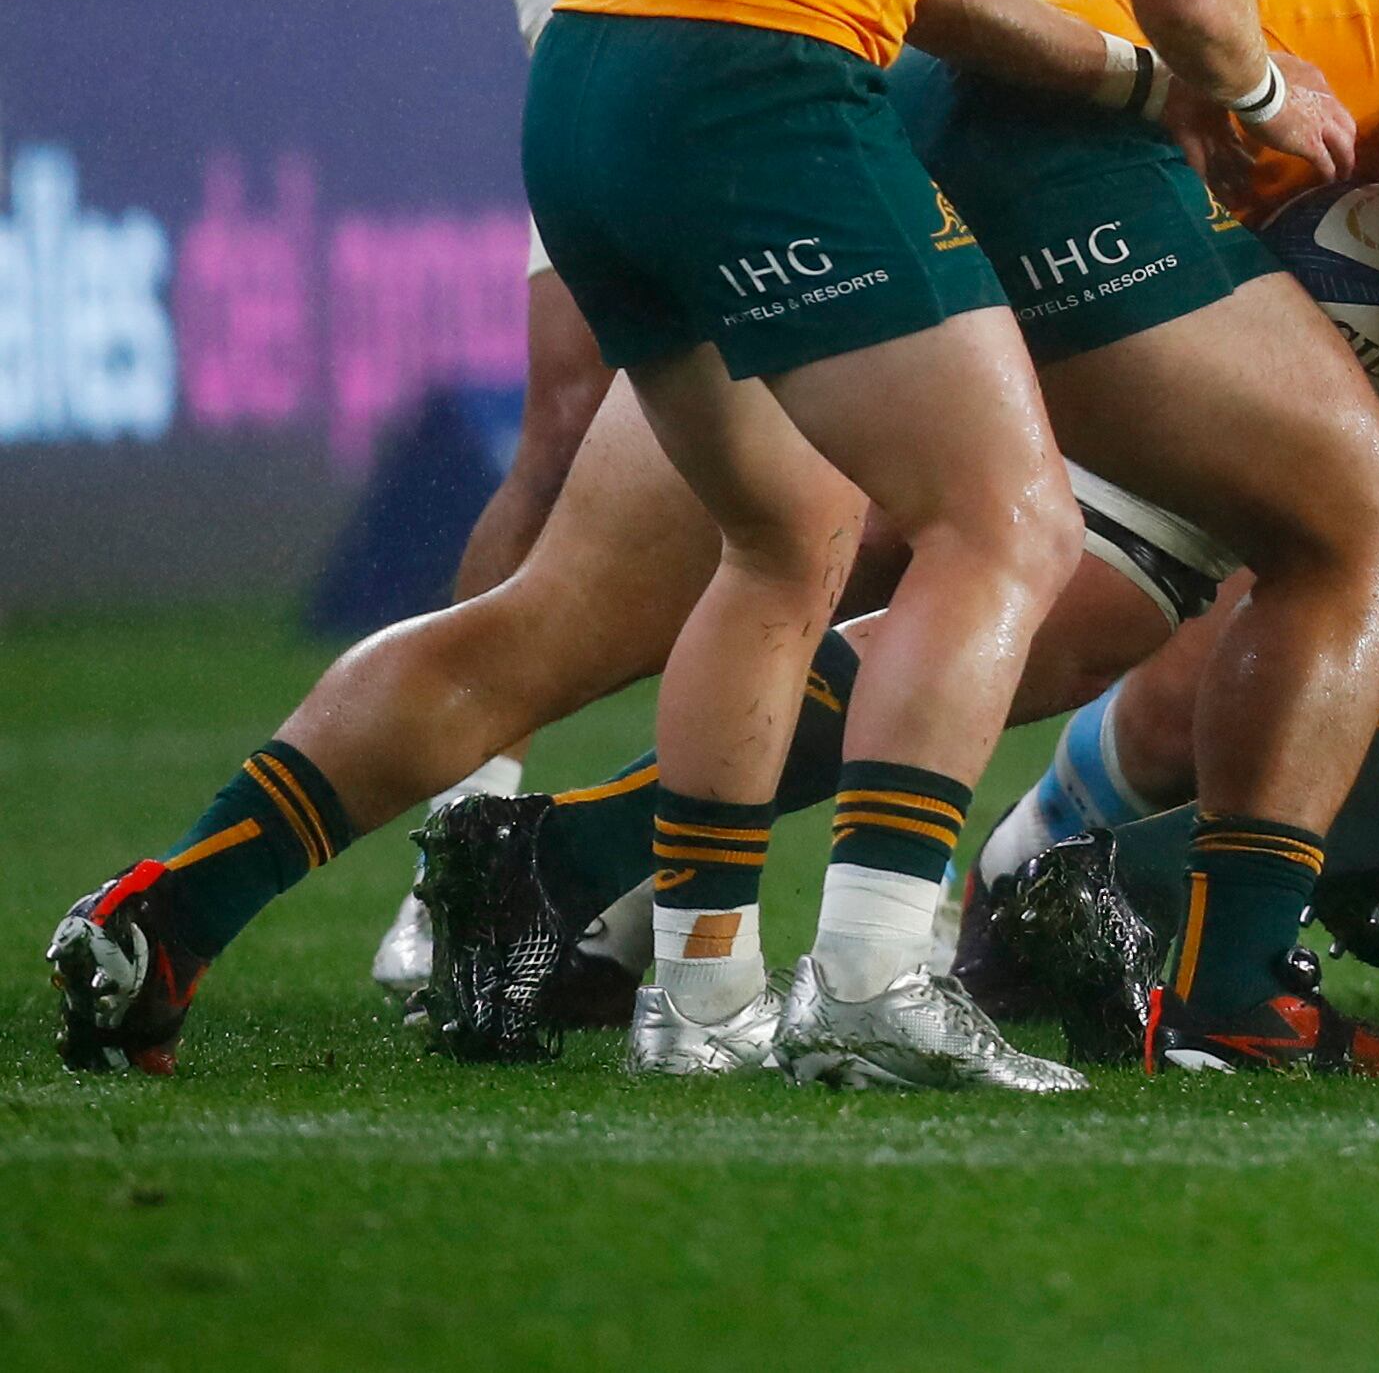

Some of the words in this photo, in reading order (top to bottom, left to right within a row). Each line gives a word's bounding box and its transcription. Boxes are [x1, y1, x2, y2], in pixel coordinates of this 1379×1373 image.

[718, 237, 834, 297] IHG
[1020, 221, 1131, 291] IHG
[1083, 289, 1096, 302] &
[1098, 253, 1179, 297] RESORTS
[801, 269, 890, 305] RESORTS
